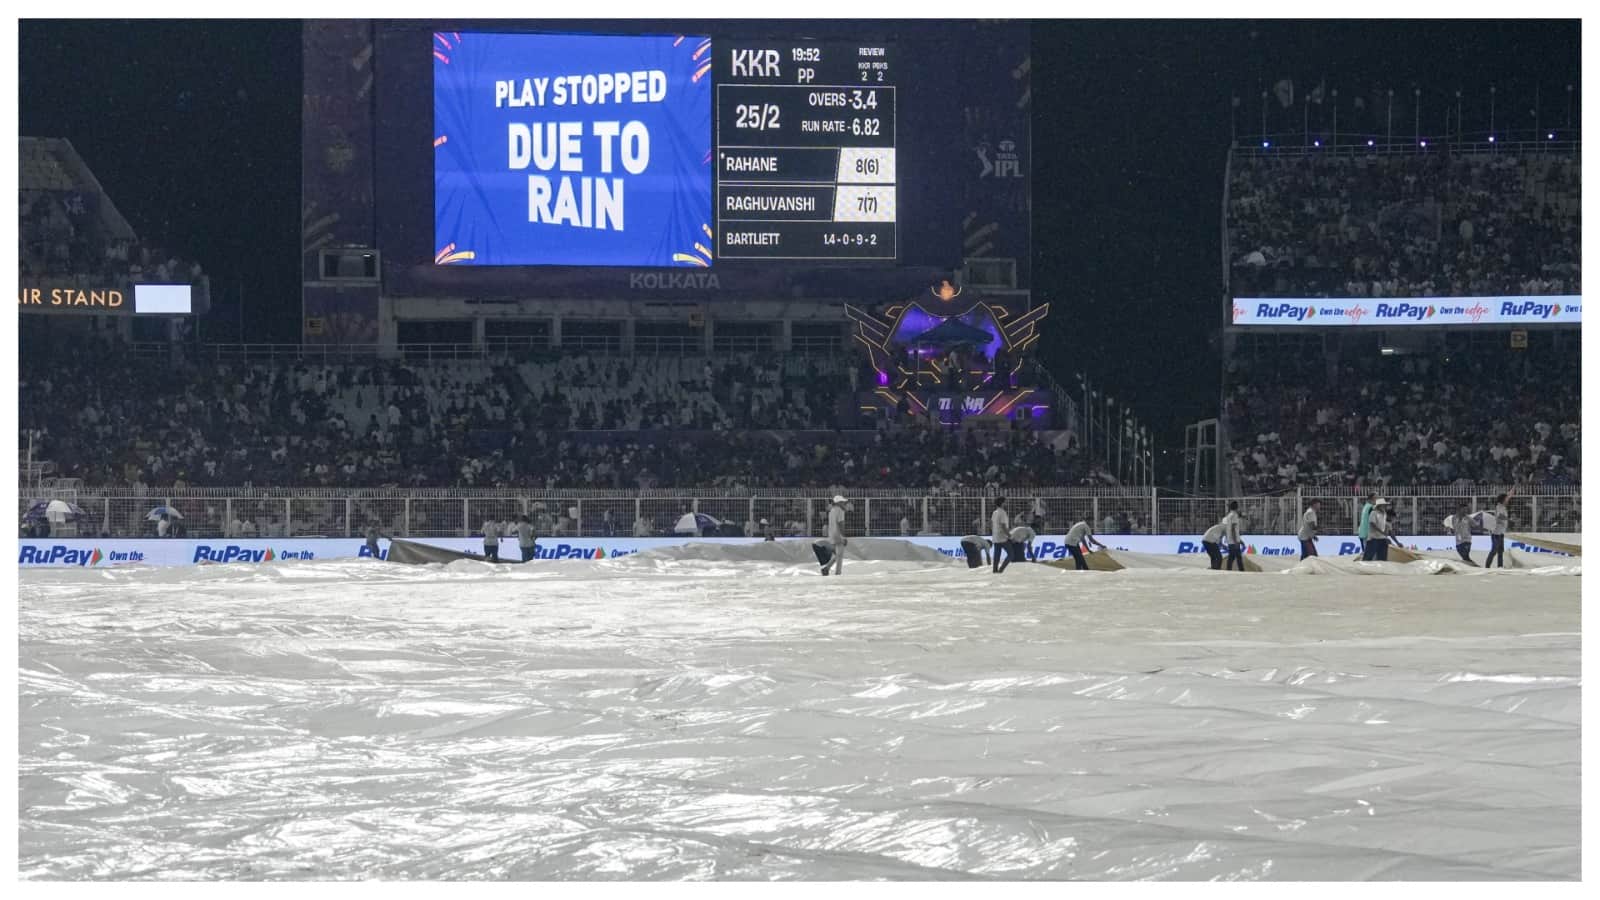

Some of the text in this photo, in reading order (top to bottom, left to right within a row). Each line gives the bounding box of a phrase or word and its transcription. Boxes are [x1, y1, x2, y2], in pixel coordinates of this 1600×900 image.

[792, 48, 820, 61] 19:52
[859, 48, 885, 56] REVIEW
[731, 49, 781, 77] KKR
[798, 68, 814, 83] PP
[861, 71, 883, 81] 2 2
[495, 70, 667, 108] PLAY STOPPED
[809, 93, 846, 106] OVERS
[735, 104, 781, 131] 25/2
[802, 121, 820, 132] RUN
[822, 121, 845, 132] RATE
[508, 119, 650, 175] DUE TO
[726, 157, 778, 172] RAHANE
[855, 158, 880, 175] 8(6)
[994, 160, 1024, 177] IPL
[527, 174, 624, 232] RAIN
[726, 197, 815, 211] RAGHUVANSHI
[857, 196, 878, 213] 7(7)
[726, 232, 780, 245] BARTLIETT
[629, 272, 720, 289] KOLKATA
[51, 289, 123, 307] STAND
[1256, 303, 1308, 321] RuPay
[1319, 307, 1333, 316] Own
[1333, 307, 1344, 316] the
[1375, 303, 1428, 320] RuPay
[1440, 306, 1453, 315] Own
[1454, 306, 1464, 315] the
[1500, 301, 1553, 319] RuPay
[1565, 304, 1579, 313] Own
[18, 545, 144, 567] RuPay Own the
[281, 550, 299, 560] Own
[300, 550, 314, 560] the
[1262, 547, 1280, 556] Own
[1281, 547, 1295, 556] the
